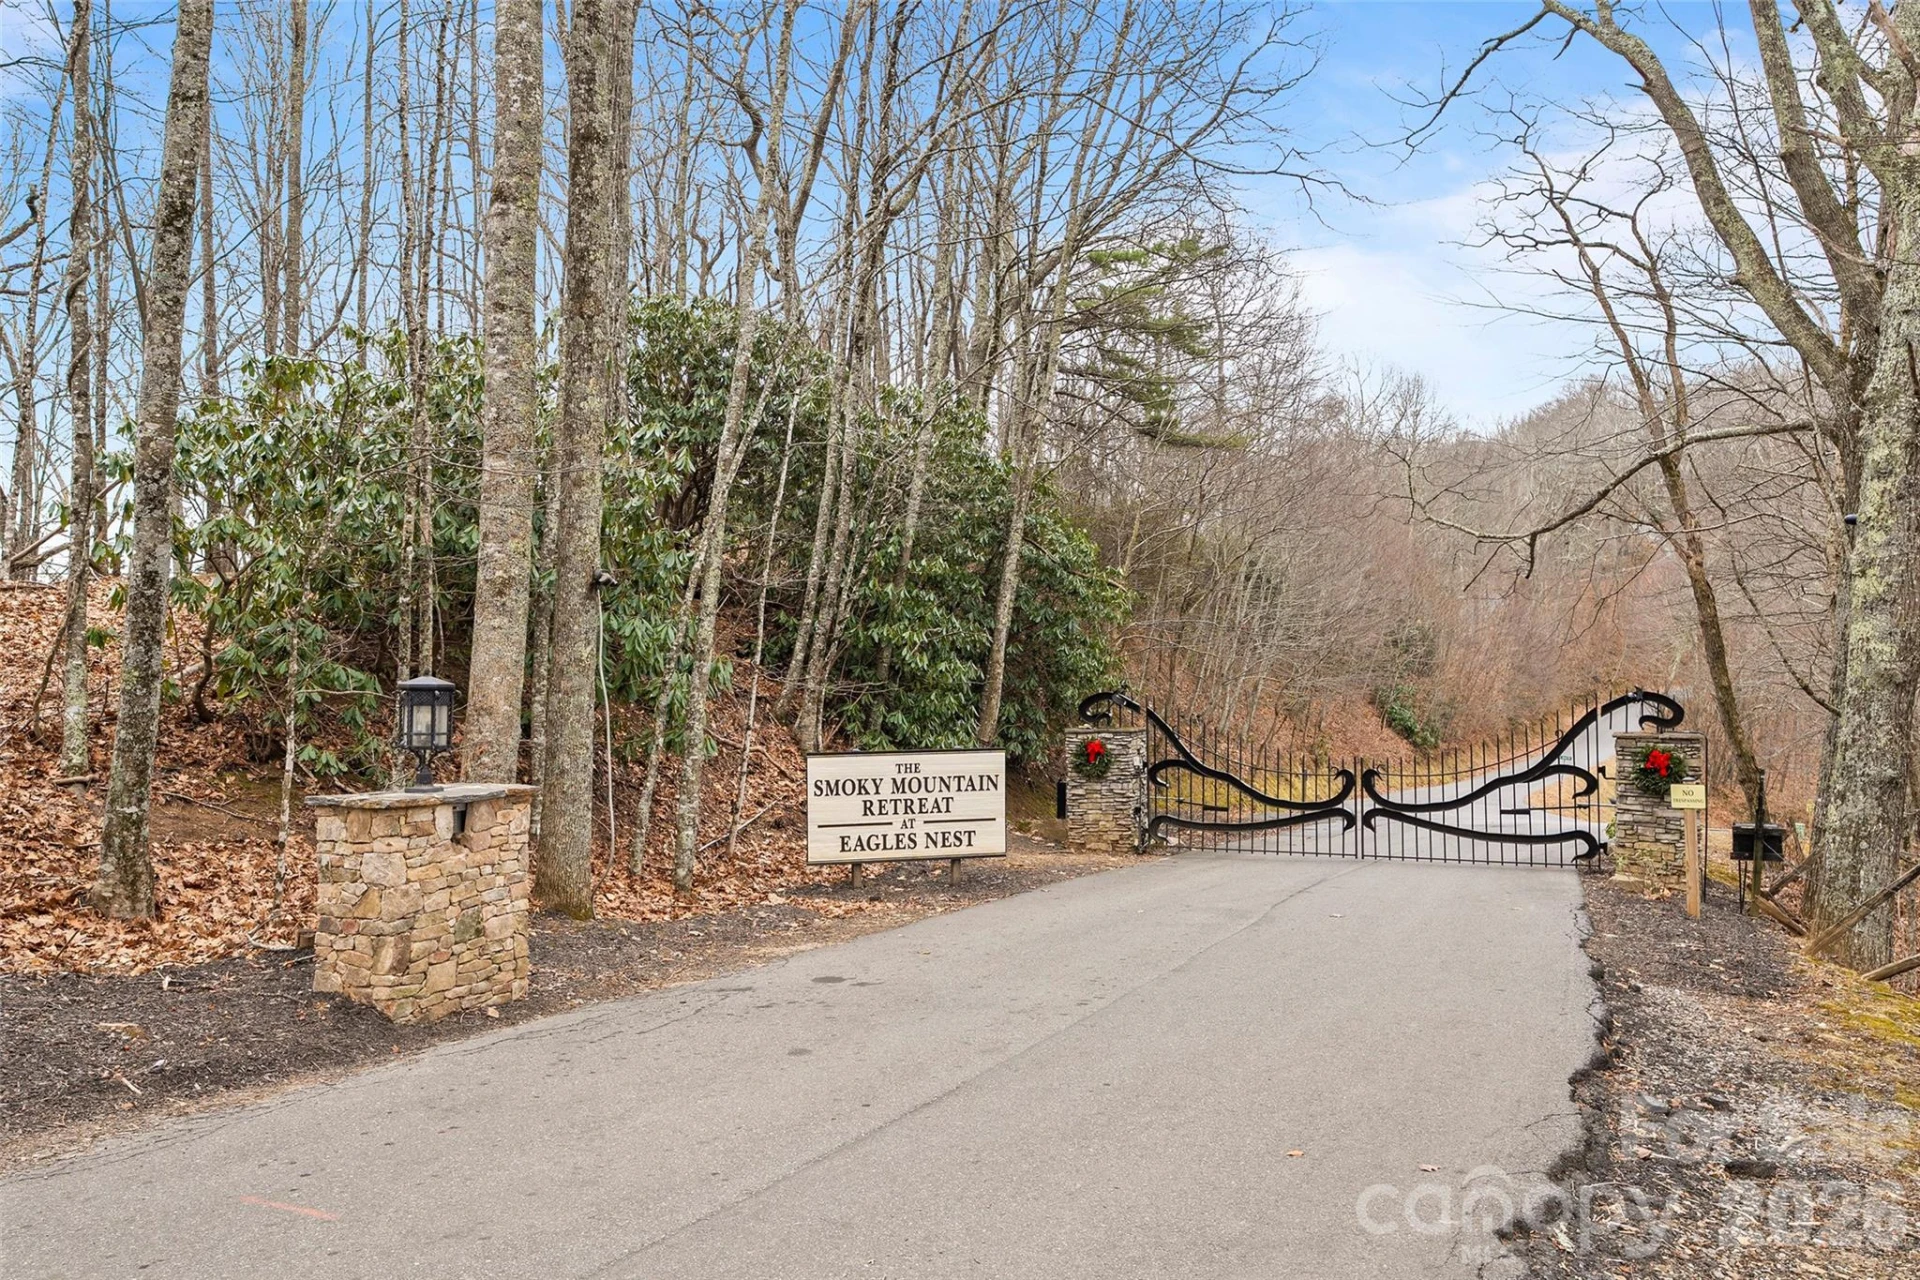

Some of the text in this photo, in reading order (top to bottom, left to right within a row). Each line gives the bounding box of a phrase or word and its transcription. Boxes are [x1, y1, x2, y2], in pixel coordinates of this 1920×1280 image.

[895, 763, 921, 774] THE
[813, 774, 1000, 797] SMOKY MOUNTAIN
[1682, 789, 1695, 797] NO
[862, 796, 954, 816] RETREAT
[900, 818, 916, 830] AT
[839, 830, 977, 853] EAGLES NEST
